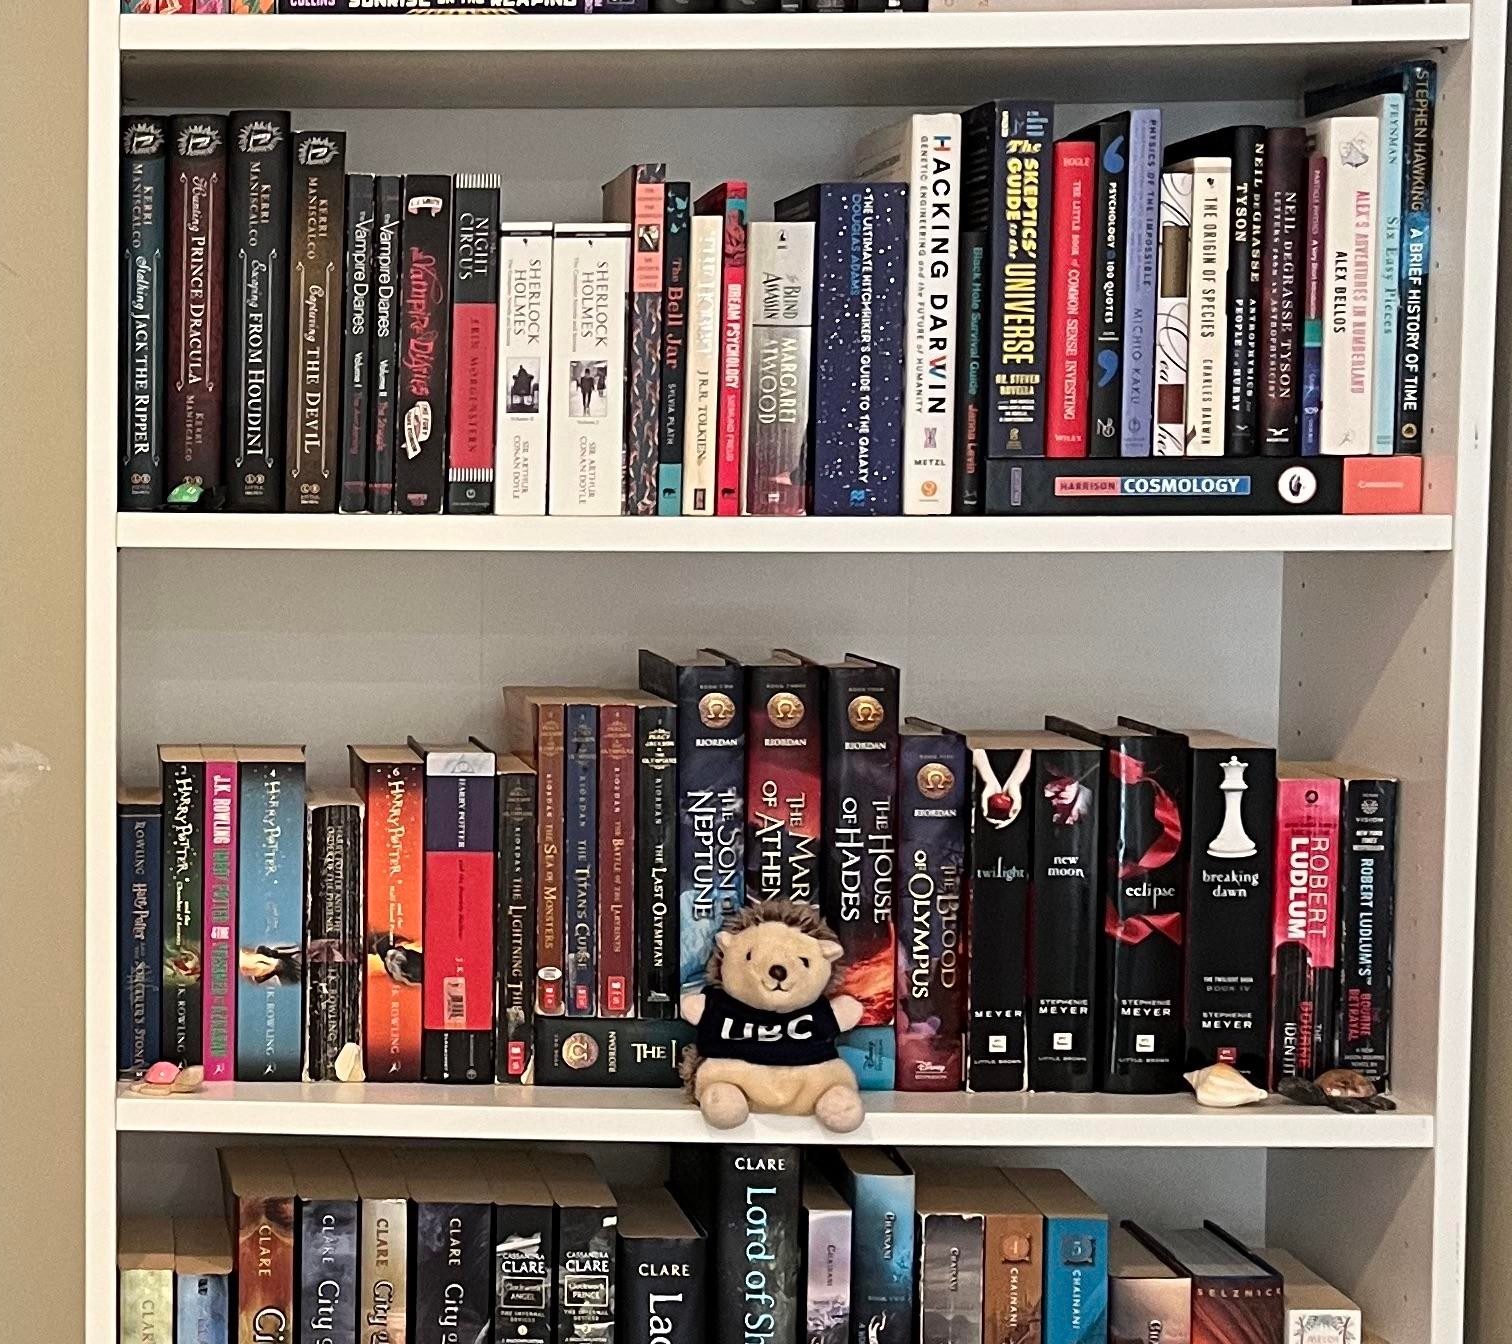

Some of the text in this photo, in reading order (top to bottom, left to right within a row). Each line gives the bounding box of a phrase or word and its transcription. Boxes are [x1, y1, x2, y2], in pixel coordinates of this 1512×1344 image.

[1007, 160, 1022, 221] GUIDE
[1022, 158, 1039, 260] SKEPTICS'
[459, 213, 473, 280] CIRCUS
[474, 217, 488, 276] NIGHT
[929, 135, 952, 414] HACKING DARWIN
[514, 270, 526, 336] HOLMES
[529, 259, 540, 345] SHERLOCK
[1002, 263, 1036, 365] UNIVERSE
[1404, 228, 1422, 411] A BRIEF HISTORY OF TIME
[133, 313, 150, 355] JACK
[134, 362, 149, 391] THE
[134, 394, 150, 455] RIPPER
[1060, 478, 1239, 493] HARRISON COSMOLOGY
[695, 738, 738, 747] RIORDAN
[845, 741, 886, 750] RIORDAN
[688, 791, 716, 922] NEPTUNE
[835, 827, 864, 923] HADES
[868, 832, 895, 924] HOUSE
[977, 857, 1025, 880] twilight
[1047, 867, 1084, 877] moon
[1054, 856, 1079, 865] new
[1203, 871, 1259, 886] breaking
[1126, 883, 1175, 909] eclipse
[1212, 885, 1247, 898] dawn
[1288, 837, 1309, 939] LUDLUM
[1309, 837, 1329, 939] ROBERT
[907, 872, 934, 1000] OLYMPUS
[1121, 1008, 1171, 1016] MEYER
[734, 1158, 785, 1171] CLARE
[746, 1187, 776, 1262] Lord
[502, 1260, 545, 1274] CLARE
[639, 1264, 691, 1277] CLARE
[746, 1269, 774, 1298] of
